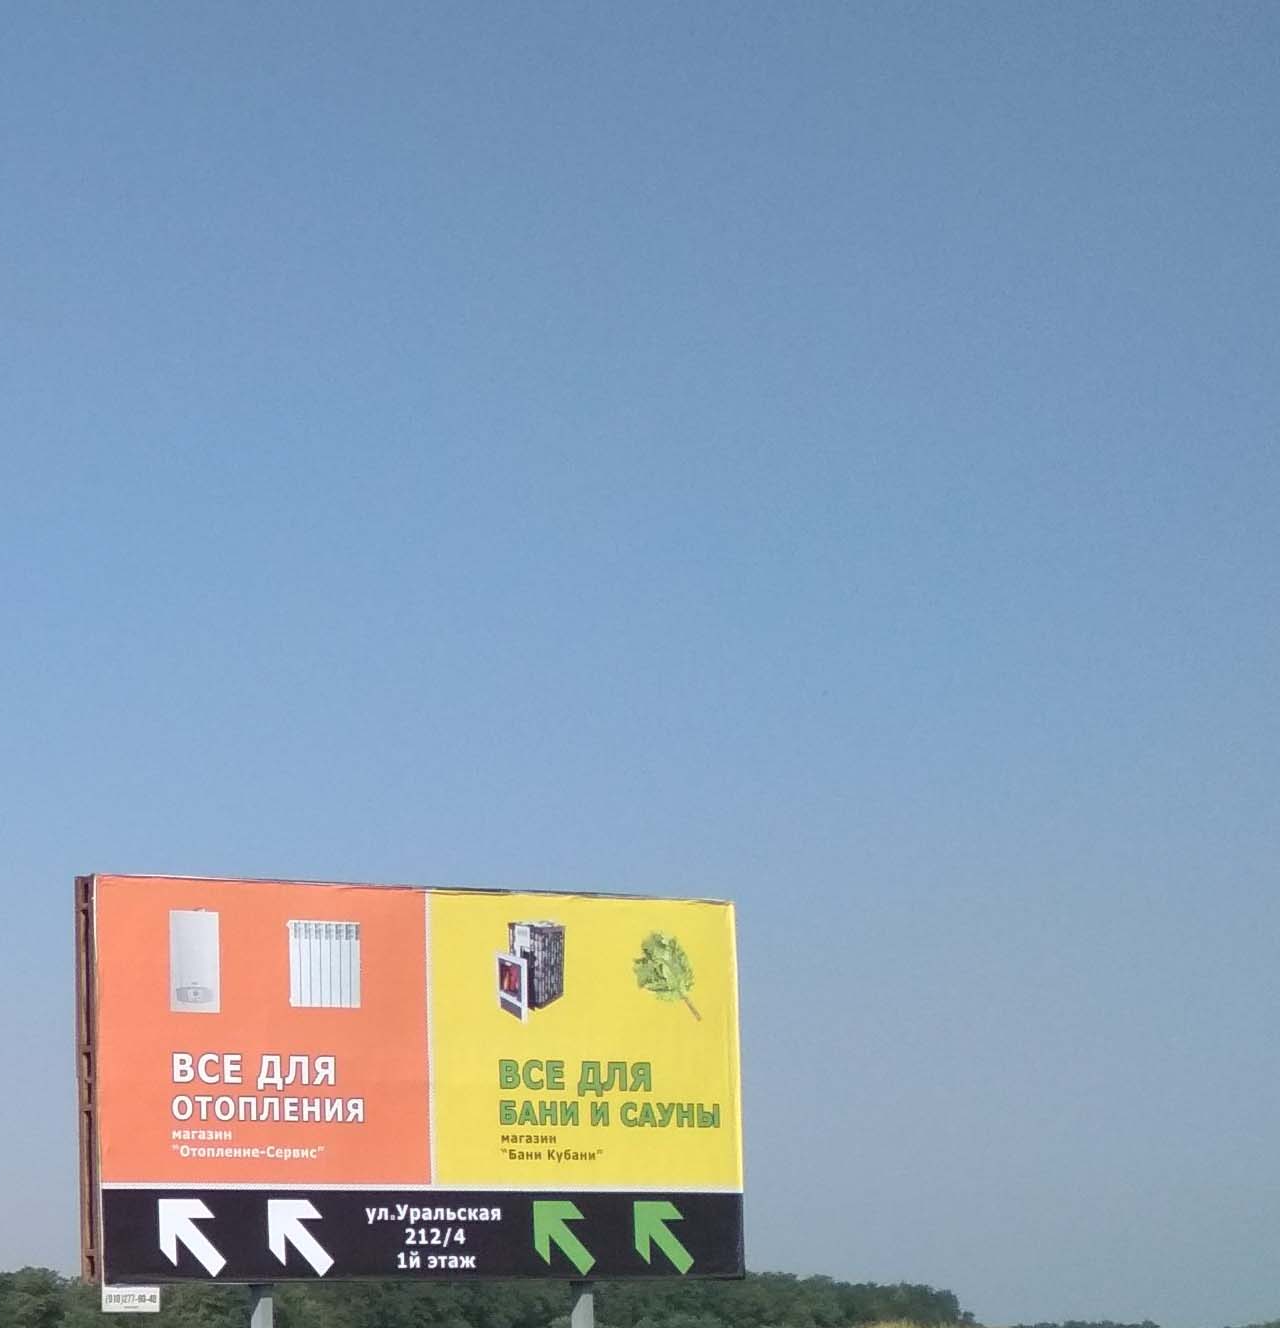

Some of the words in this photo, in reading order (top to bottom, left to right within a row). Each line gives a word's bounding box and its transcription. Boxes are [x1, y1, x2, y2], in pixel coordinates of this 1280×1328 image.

[171, 1052, 243, 1084] ВСЕ
[256, 1054, 337, 1091] ДЛЯ
[498, 1058, 565, 1090] ВСЕ
[577, 1060, 652, 1097] ДЛЯ
[171, 1095, 365, 1123] ОТОПЛЕНИЯ
[499, 1100, 579, 1126] БАНИ
[590, 1101, 610, 1126] И
[619, 1102, 721, 1128] САУНЫ
[172, 1129, 232, 1141] магазин
[501, 1134, 557, 1144] магазин
[501, 1148, 542, 1161] "Бани
[547, 1149, 604, 1163] Кубани"
[365, 1204, 502, 1225] ул.Уральская
[405, 1228, 466, 1248] 212/4
[397, 1251, 421, 1269] 1й
[427, 1255, 476, 1269] этаж
